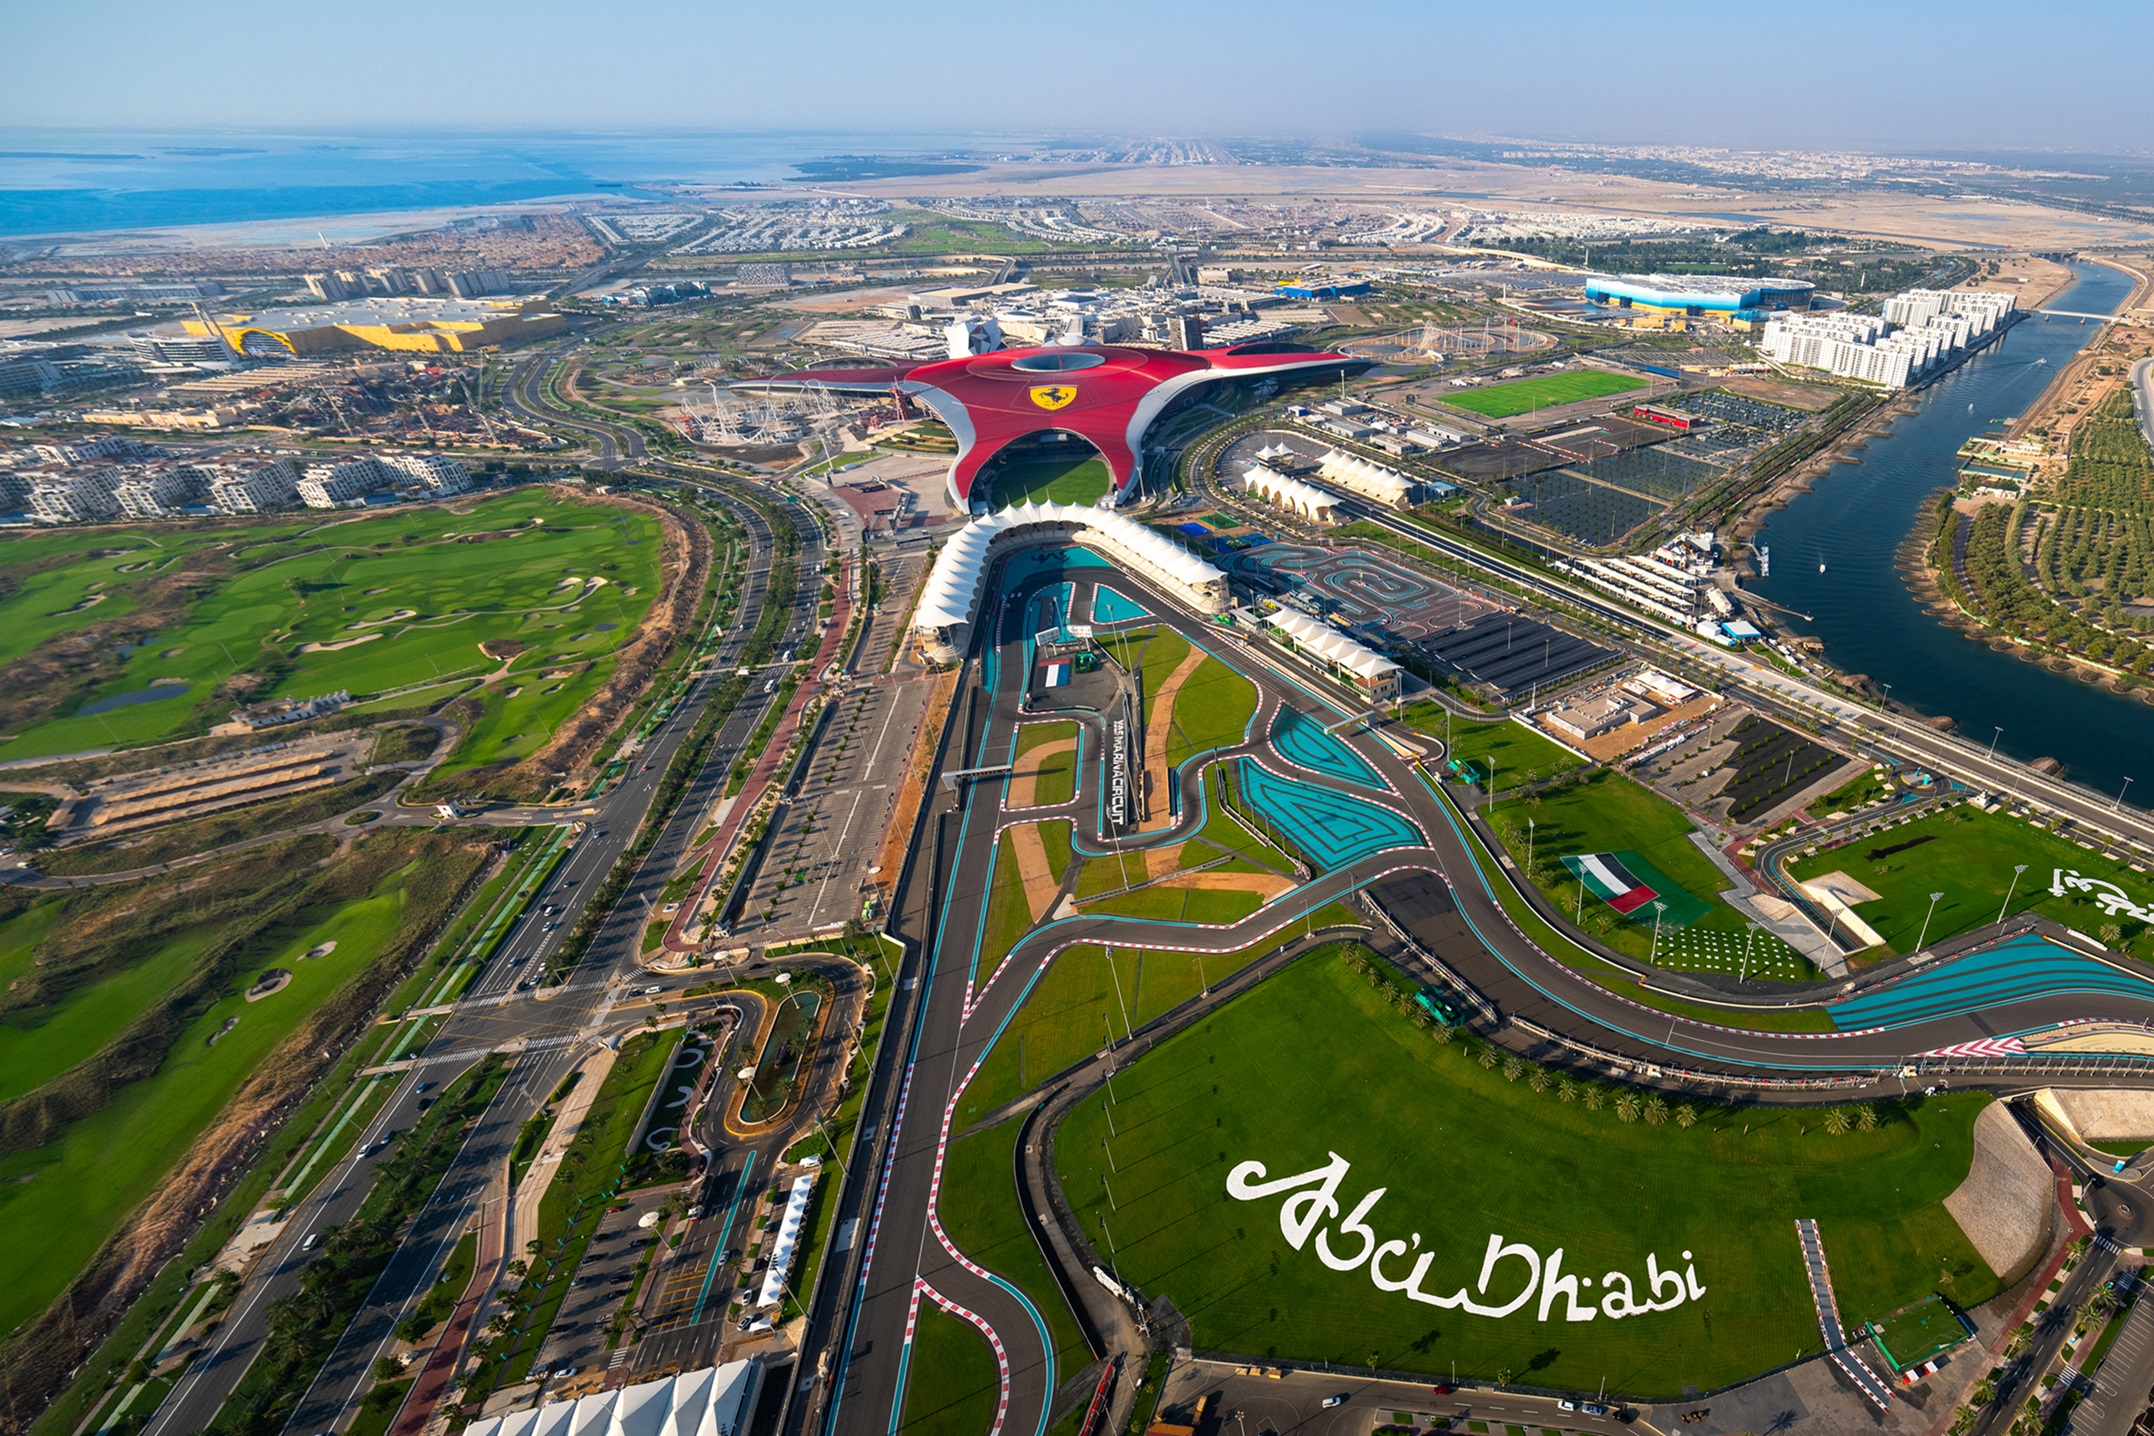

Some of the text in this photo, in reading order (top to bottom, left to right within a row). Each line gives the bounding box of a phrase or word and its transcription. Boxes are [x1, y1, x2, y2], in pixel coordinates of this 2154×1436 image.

[1112, 736, 1124, 778] MARINA
[1111, 778, 1124, 825] CIRCUIT
[1226, 1151, 1707, 1322] Abu Dhabi
